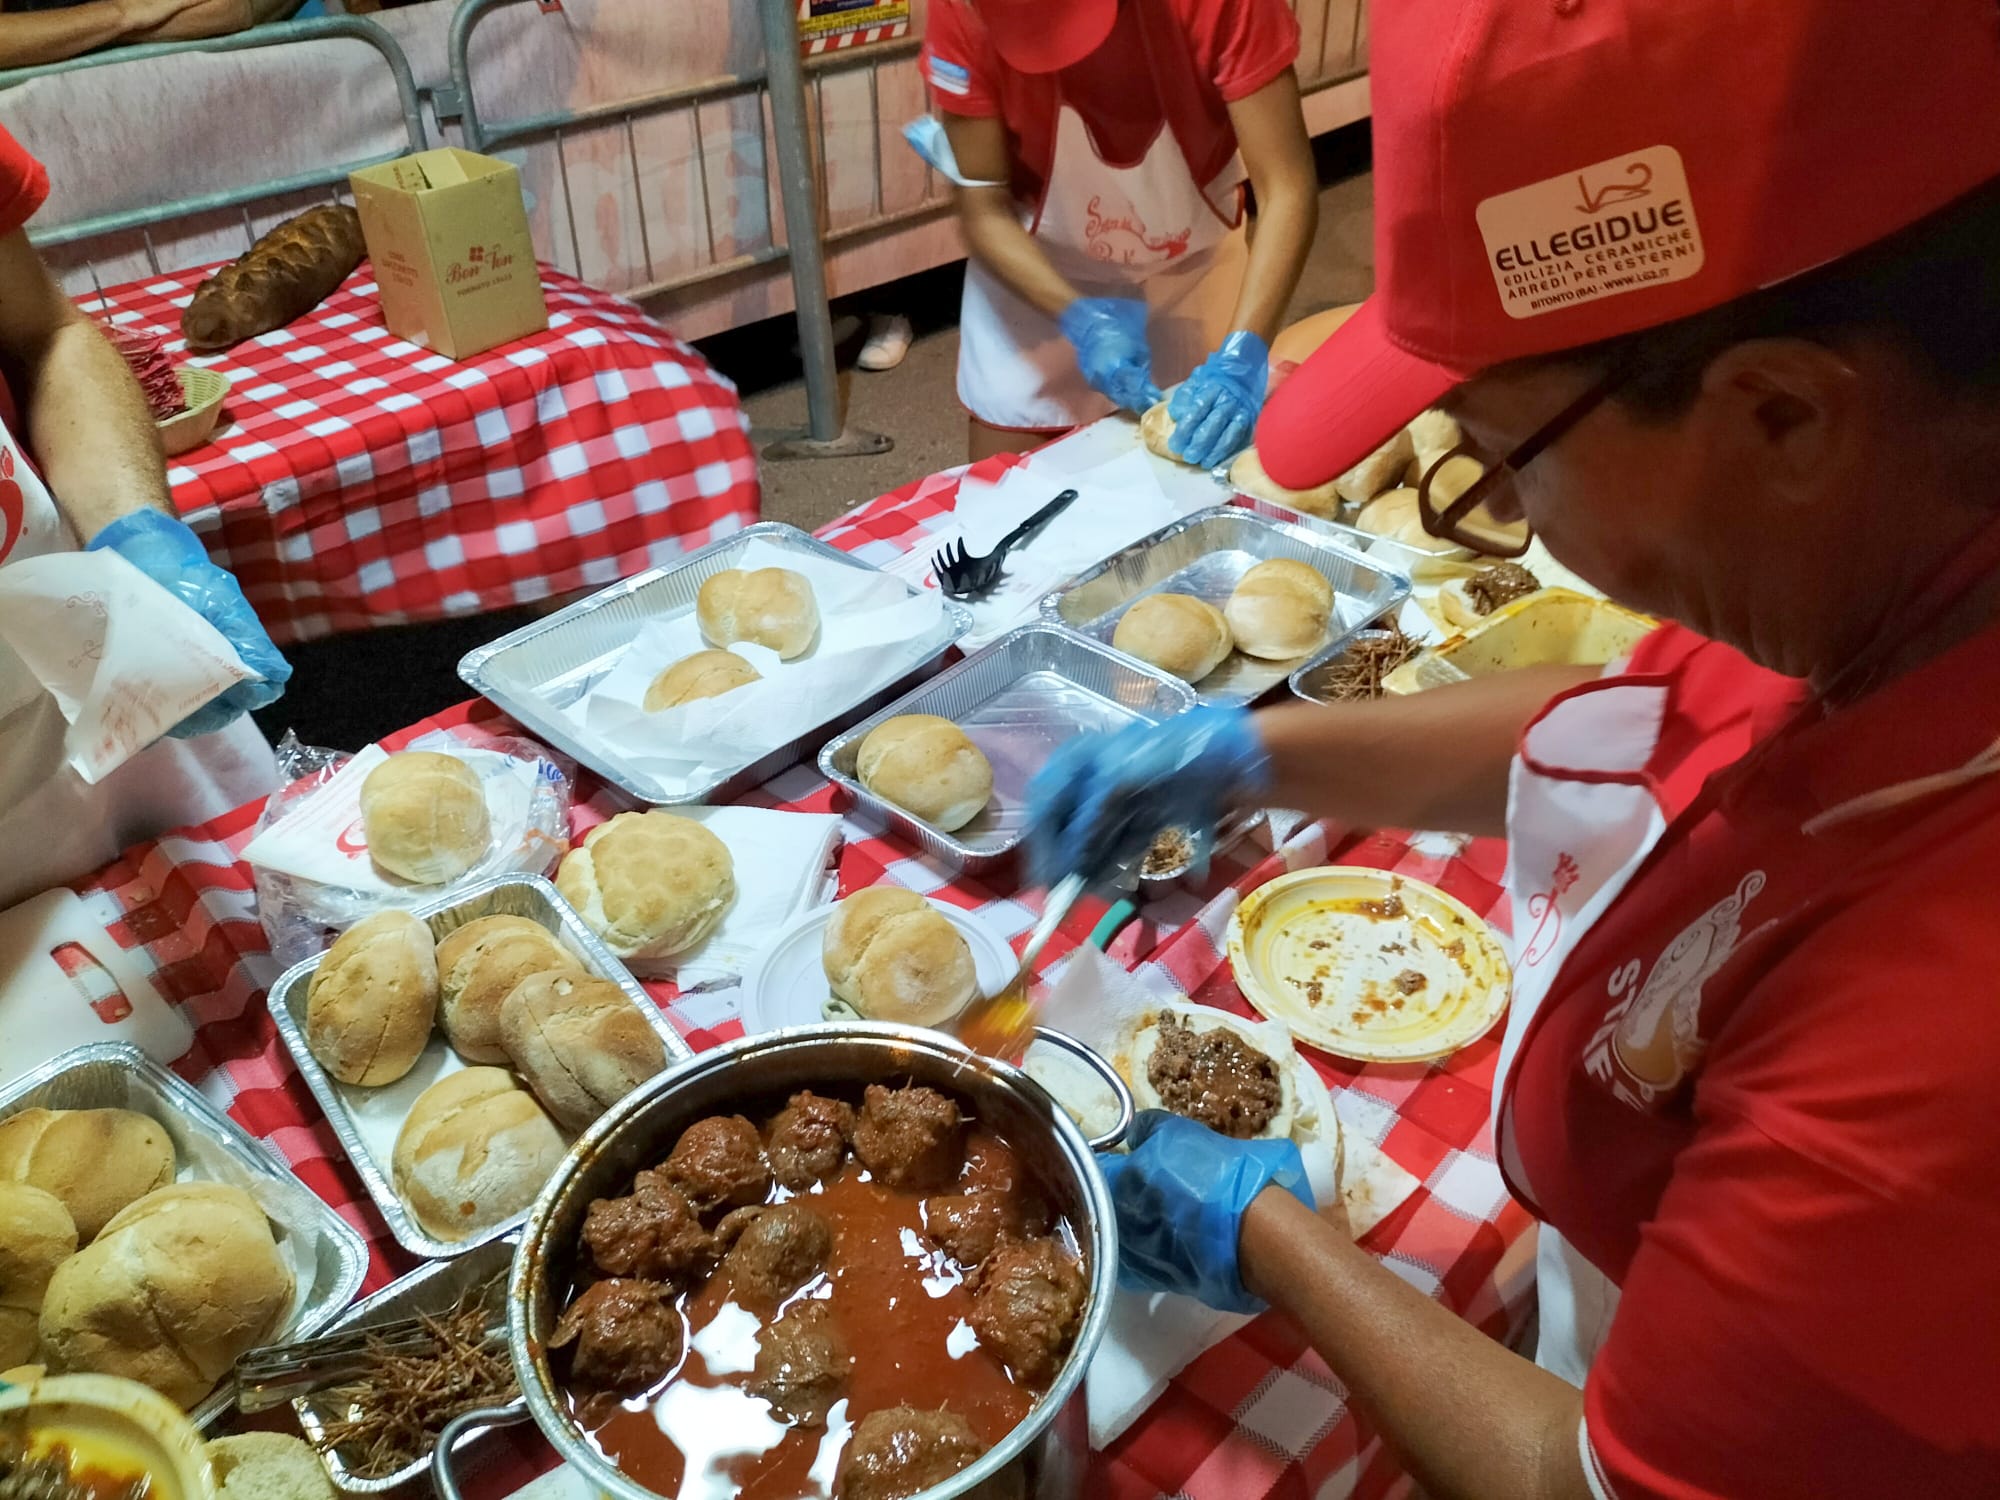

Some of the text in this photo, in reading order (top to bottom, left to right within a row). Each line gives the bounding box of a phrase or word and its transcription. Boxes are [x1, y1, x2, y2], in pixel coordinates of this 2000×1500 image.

[1495, 199, 1686, 271] ELLEGIDUE
[1503, 228, 1692, 287] EDILIZIA CERAMICHE
[1508, 243, 1696, 300] ARREDI PER ESTERNI
[1530, 290, 1575, 311] BITONTO
